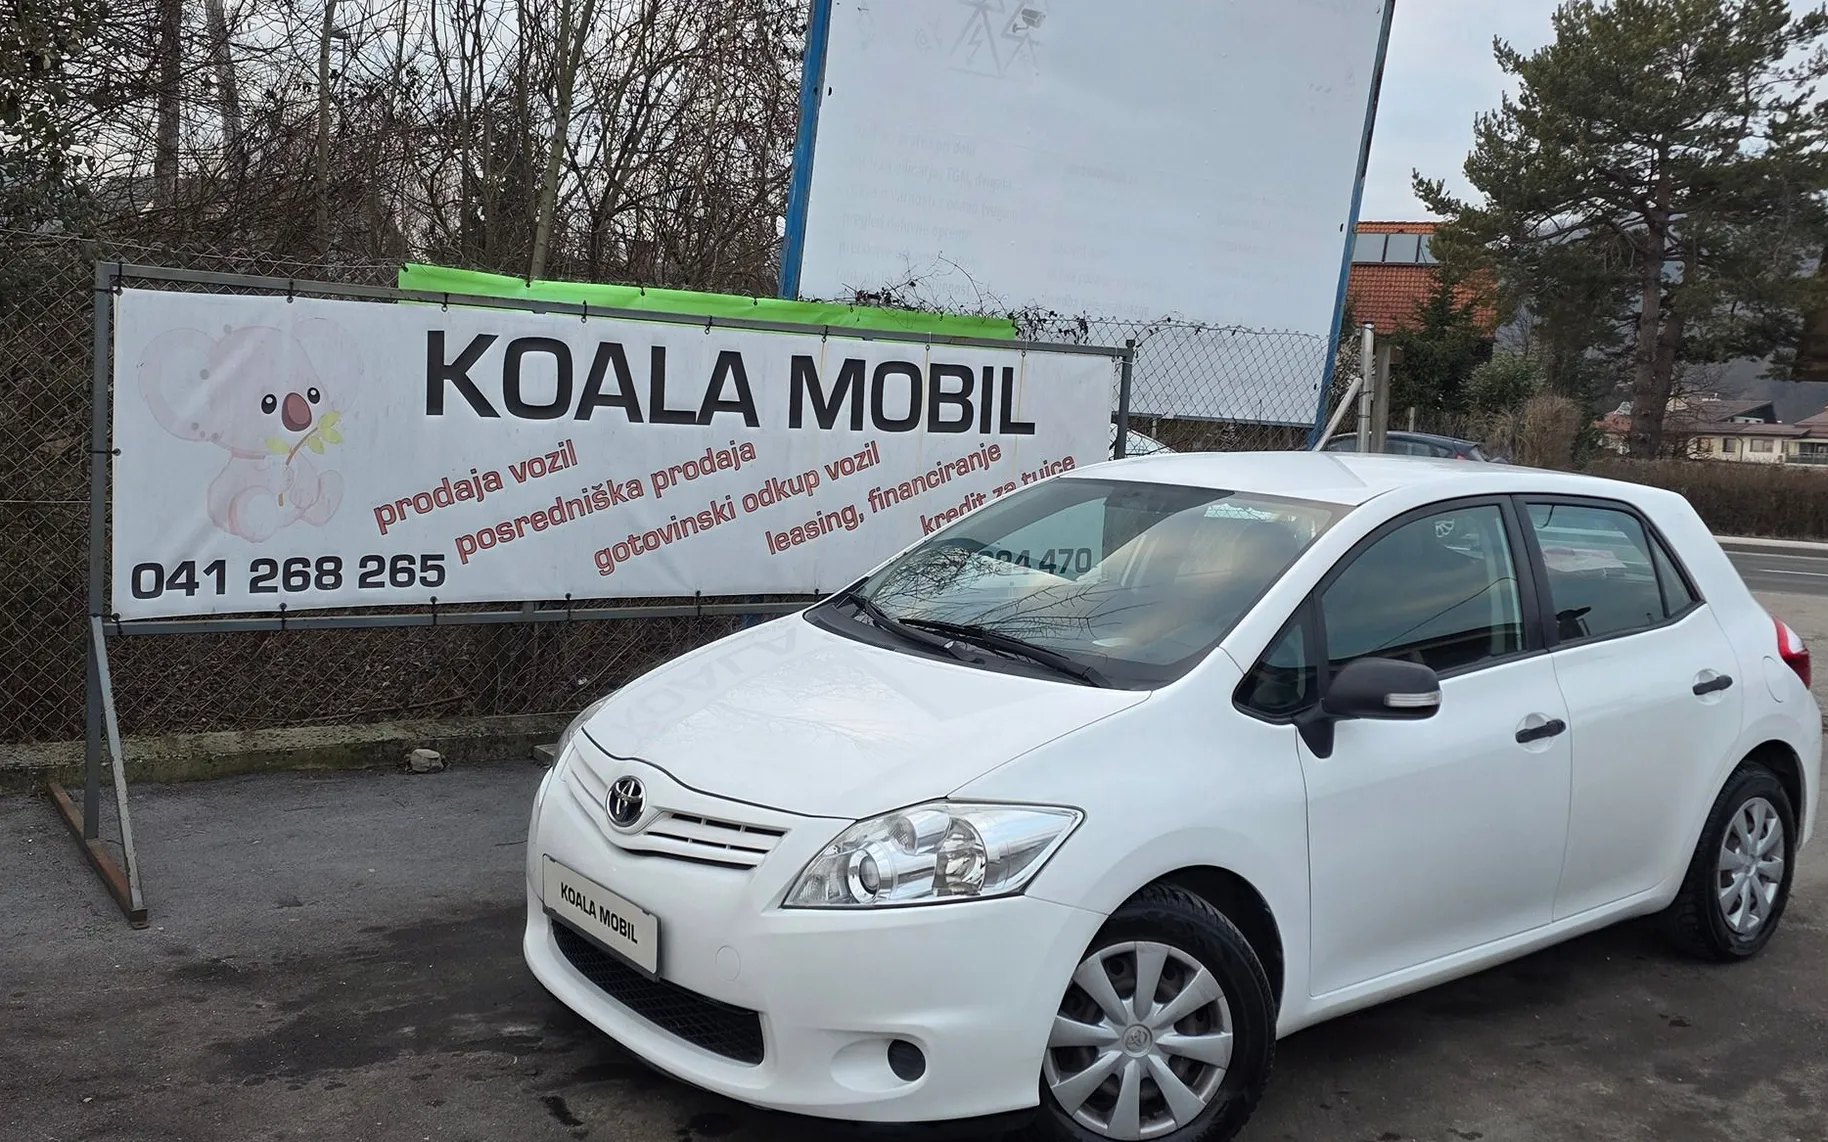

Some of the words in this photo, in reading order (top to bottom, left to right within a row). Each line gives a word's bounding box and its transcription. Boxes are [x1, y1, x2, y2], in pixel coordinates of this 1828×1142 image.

[425, 330, 760, 428] KOALA
[788, 354, 1036, 436] MOBIL
[373, 476, 504, 535] prodaja
[508, 439, 578, 484] vozil
[455, 479, 645, 565] posredniška
[650, 440, 757, 498] prodaja
[594, 495, 737, 576] gotovinski
[742, 477, 820, 514] odkup
[824, 440, 880, 481] vozil
[765, 504, 865, 555] leasing,
[867, 443, 1002, 514] financiranje
[131, 559, 227, 600] 041
[249, 555, 343, 594] 268
[359, 553, 446, 589] 265
[1038, 547, 1092, 574] 470
[560, 881, 597, 918] KOALA
[599, 906, 638, 944] MOBIL
